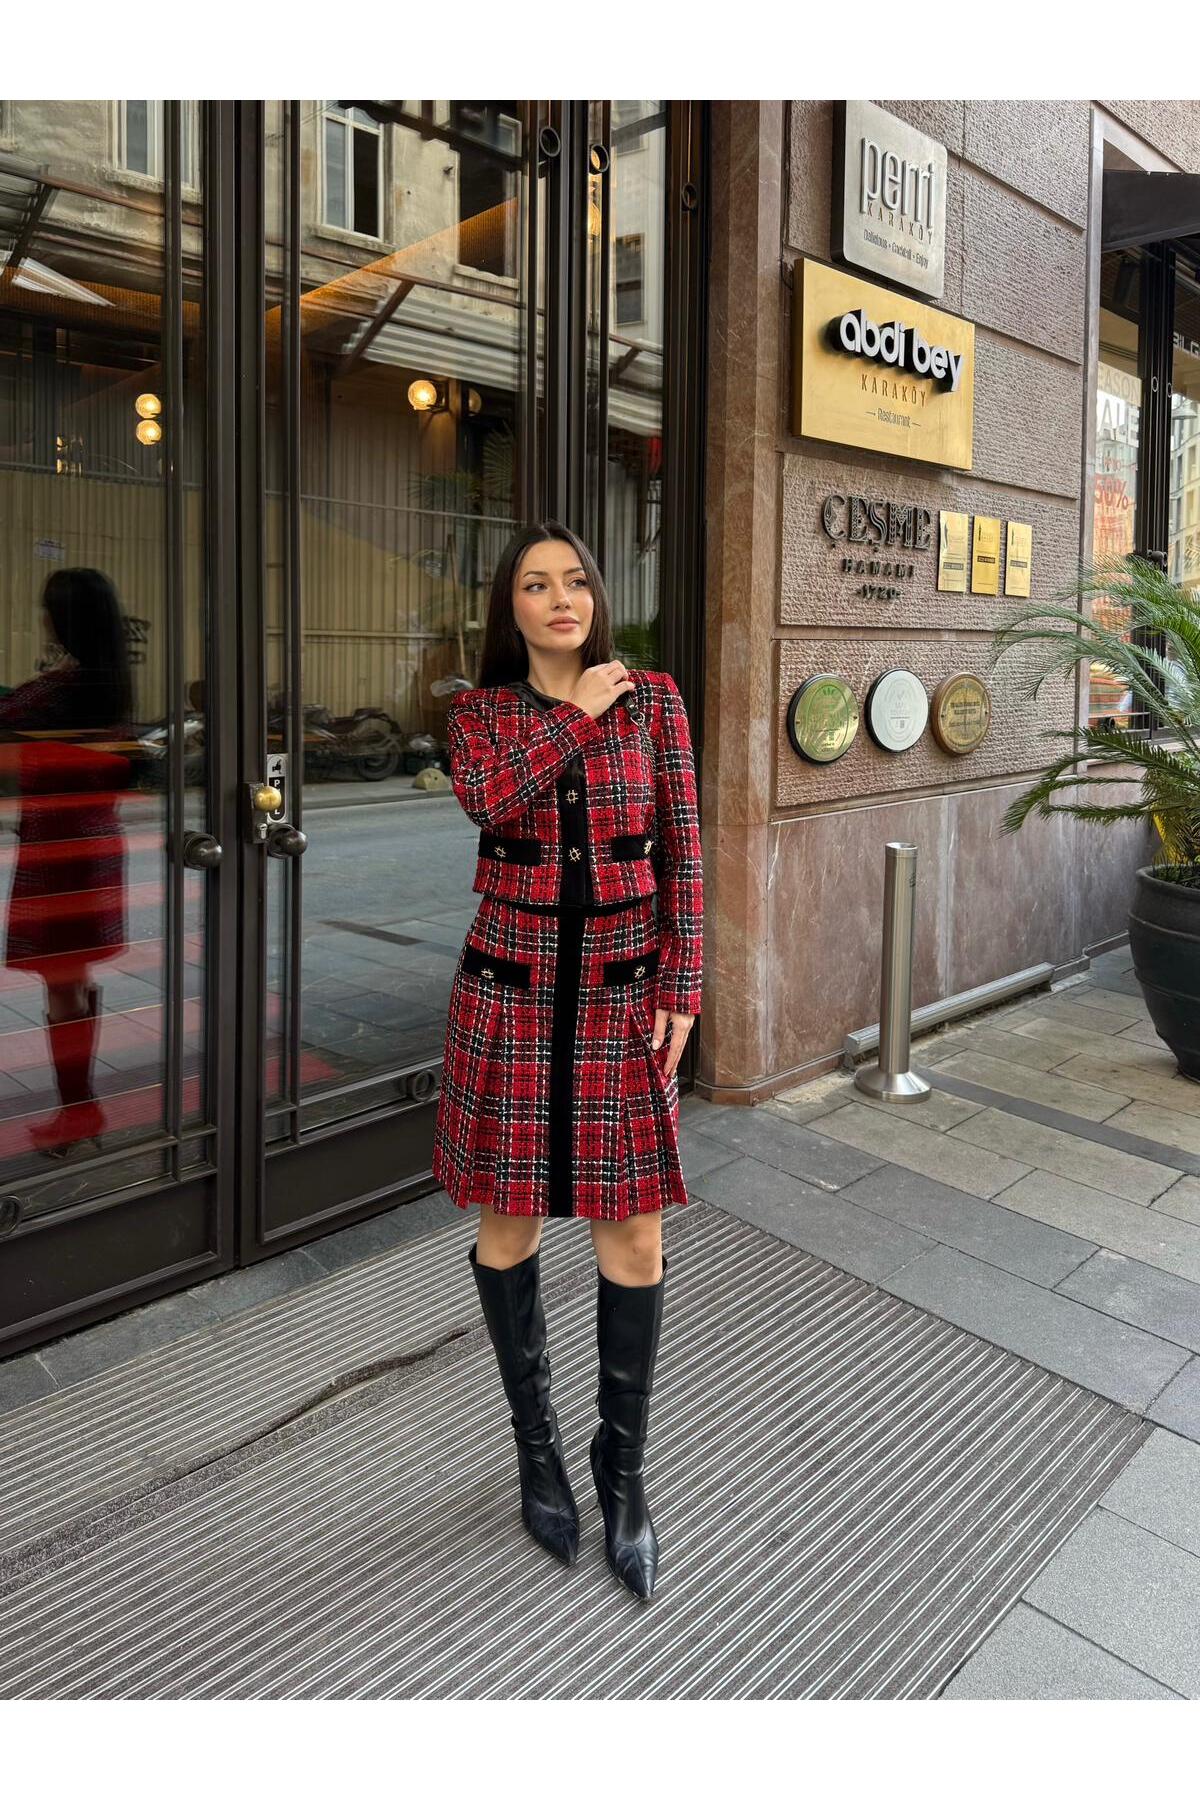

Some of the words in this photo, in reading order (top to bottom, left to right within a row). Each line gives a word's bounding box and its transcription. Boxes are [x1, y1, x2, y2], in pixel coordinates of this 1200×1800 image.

[859, 137, 935, 230] perri
[838, 309, 905, 367] abdi
[912, 328, 963, 391] bey
[861, 373, 926, 407] KARAKÖY
[877, 407, 911, 429] Restaurant
[821, 494, 931, 553] ÇEŞME
[273, 779, 281, 815] PL
